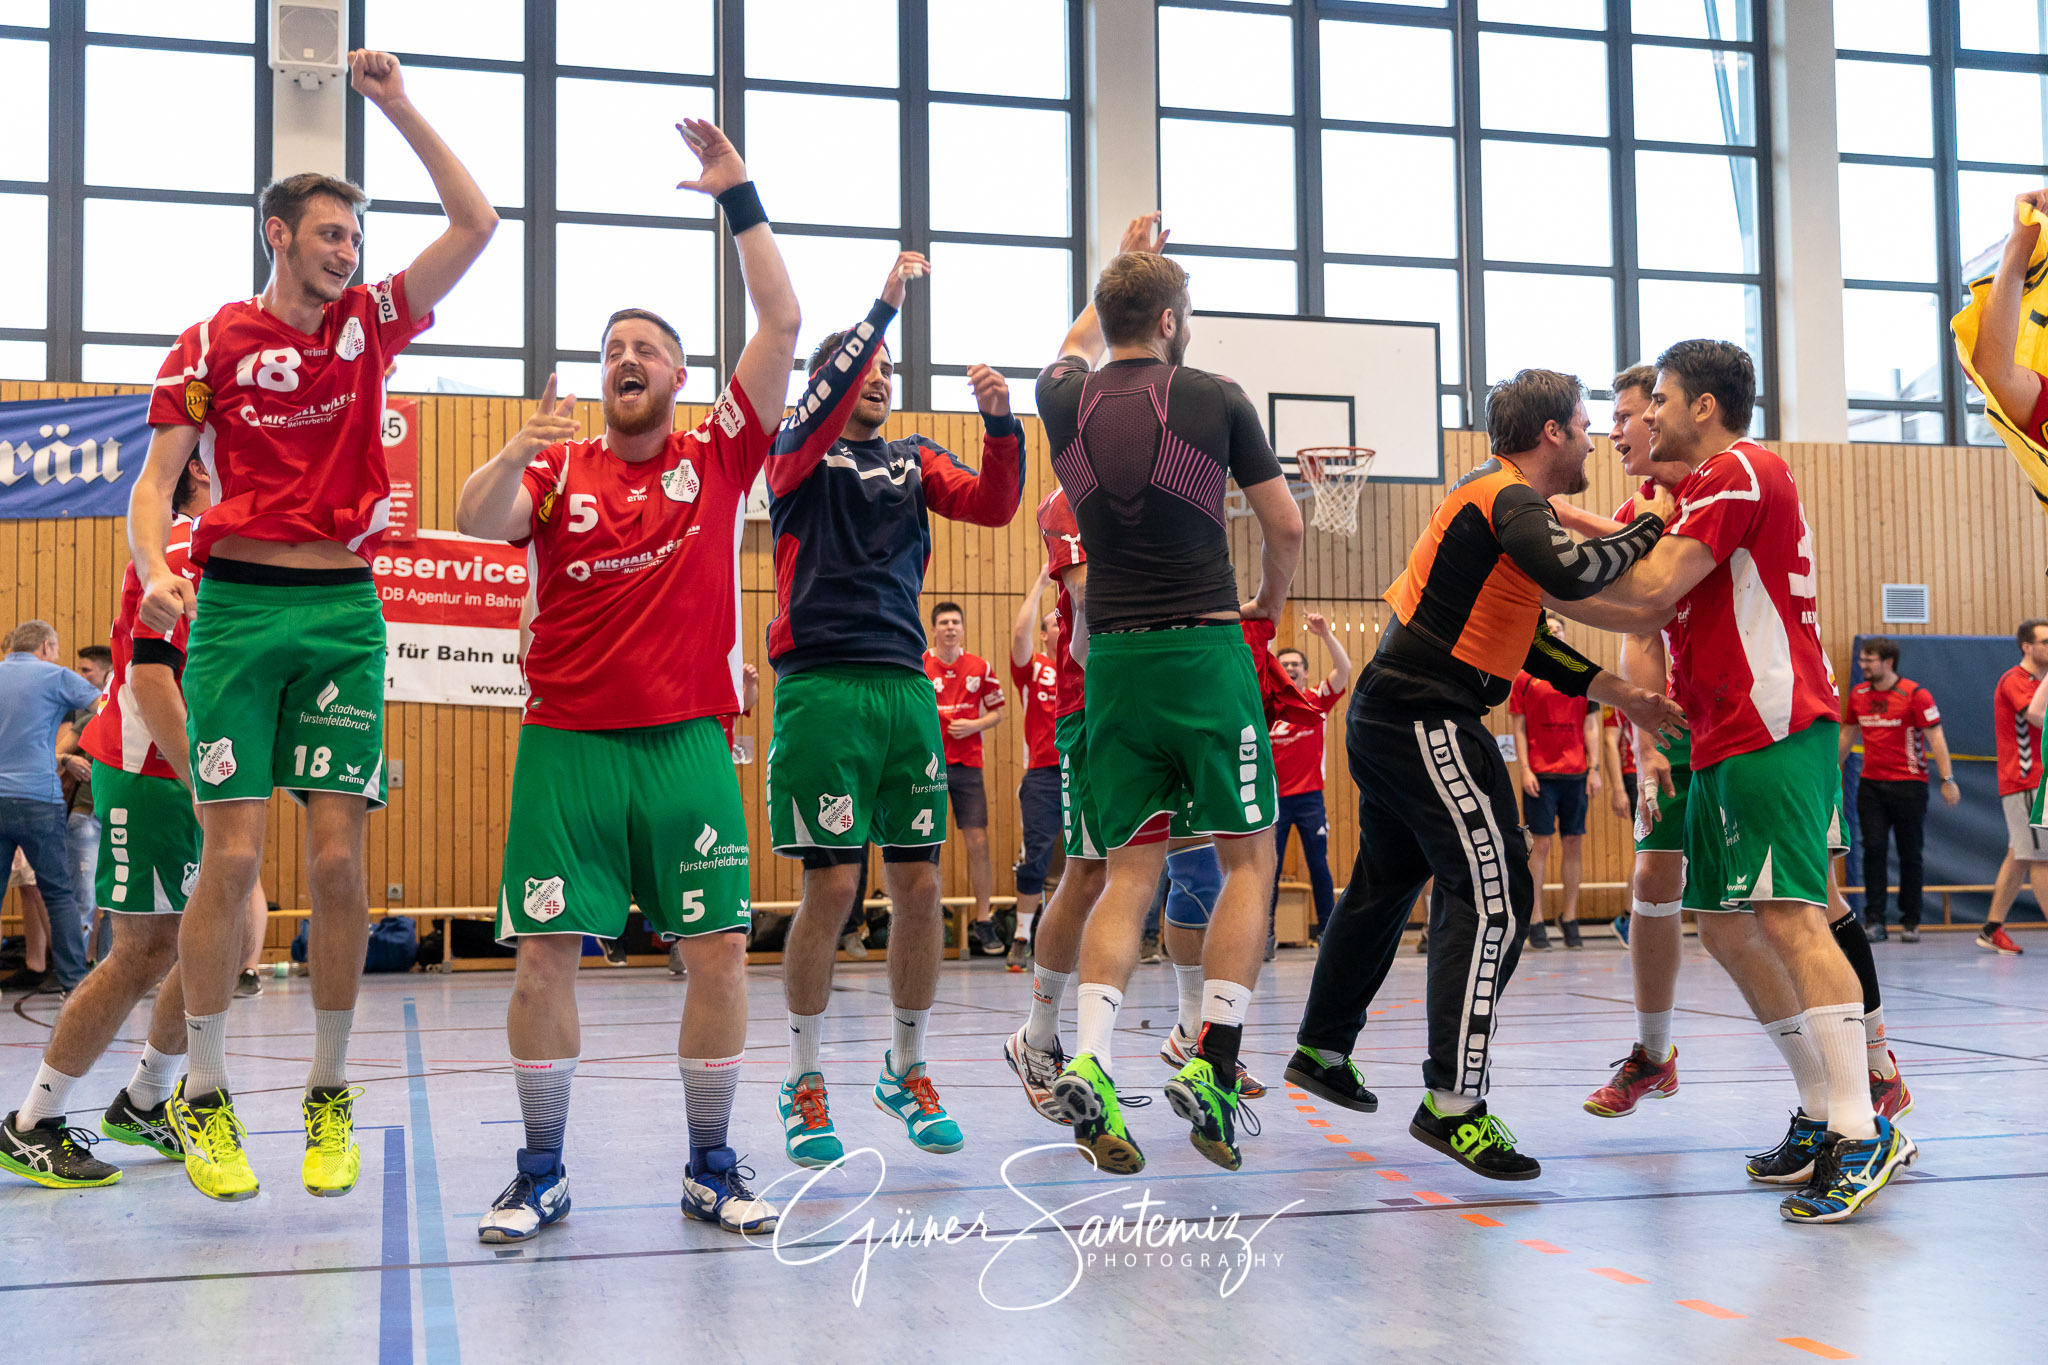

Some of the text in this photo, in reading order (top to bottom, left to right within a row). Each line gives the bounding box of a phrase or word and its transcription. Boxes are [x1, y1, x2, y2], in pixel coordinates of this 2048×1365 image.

[381, 295, 393, 321] TOP
[568, 493, 599, 533] 5
[593, 551, 653, 570] MICHAEL
[382, 587, 404, 601] DB
[406, 588, 462, 605] Agentur
[465, 593, 481, 605] im
[398, 643, 430, 660] für
[437, 645, 494, 663] Bahn
[299, 711, 371, 732] fürstenfeldbruck
[328, 703, 378, 722] stadtwerke
[294, 745, 332, 778] 18
[338, 774, 365, 786] erima
[825, 797, 848, 824] EICHENAUER
[911, 808, 935, 837] 4
[682, 888, 706, 923] 5
